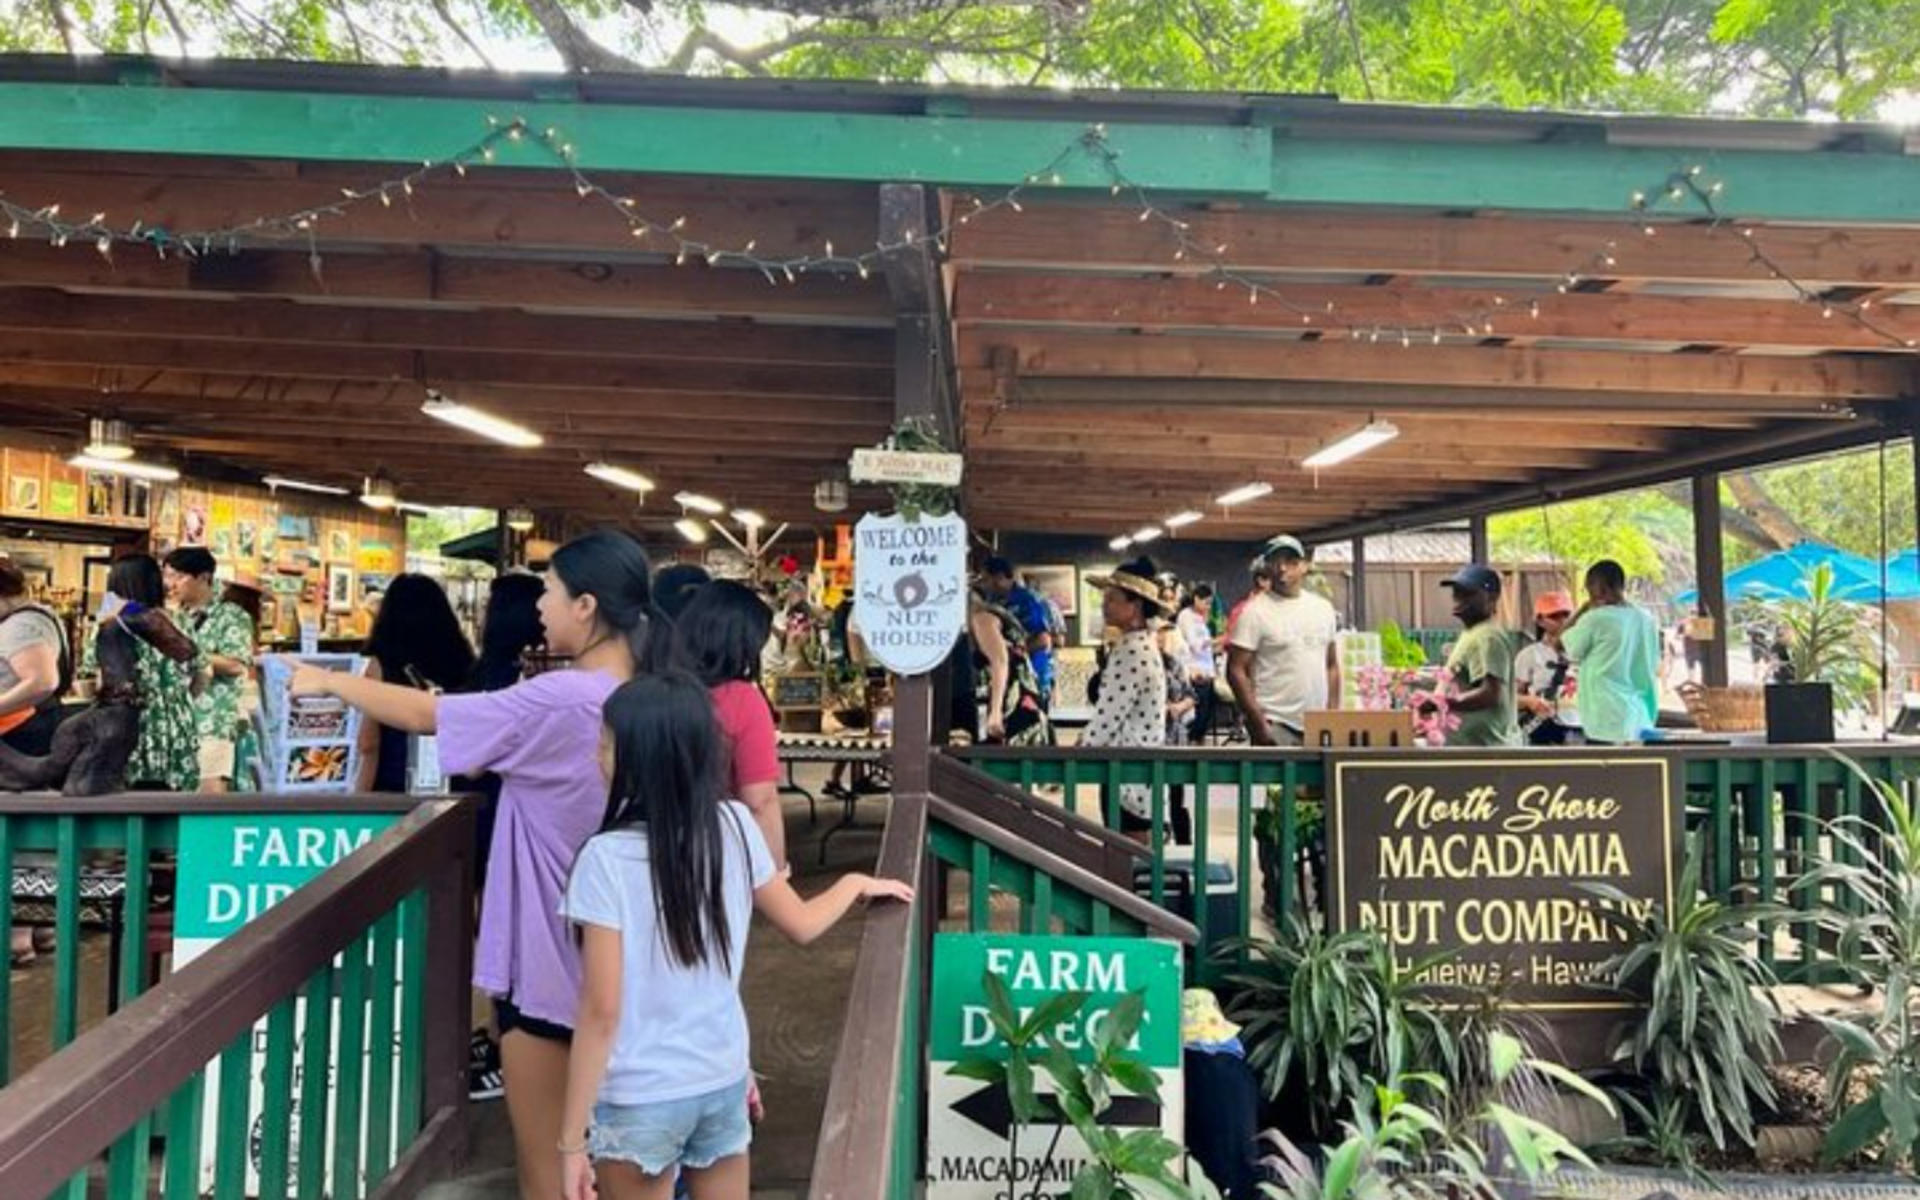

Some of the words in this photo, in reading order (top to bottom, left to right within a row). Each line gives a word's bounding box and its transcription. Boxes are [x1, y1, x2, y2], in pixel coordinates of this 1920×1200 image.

[861, 525, 958, 549] WELCOME
[889, 553, 905, 566] to
[911, 549, 938, 566] the
[887, 610, 937, 626] NUT
[871, 630, 951, 647] HOUSE
[1385, 784, 1499, 830] North
[1503, 783, 1621, 833] Shore
[231, 826, 373, 868] FARM
[1378, 832, 1631, 879] MACADAMIA
[1359, 900, 1445, 943] NUT
[986, 948, 1128, 993] FARM
[940, 1155, 1087, 1182] MACADAMI
